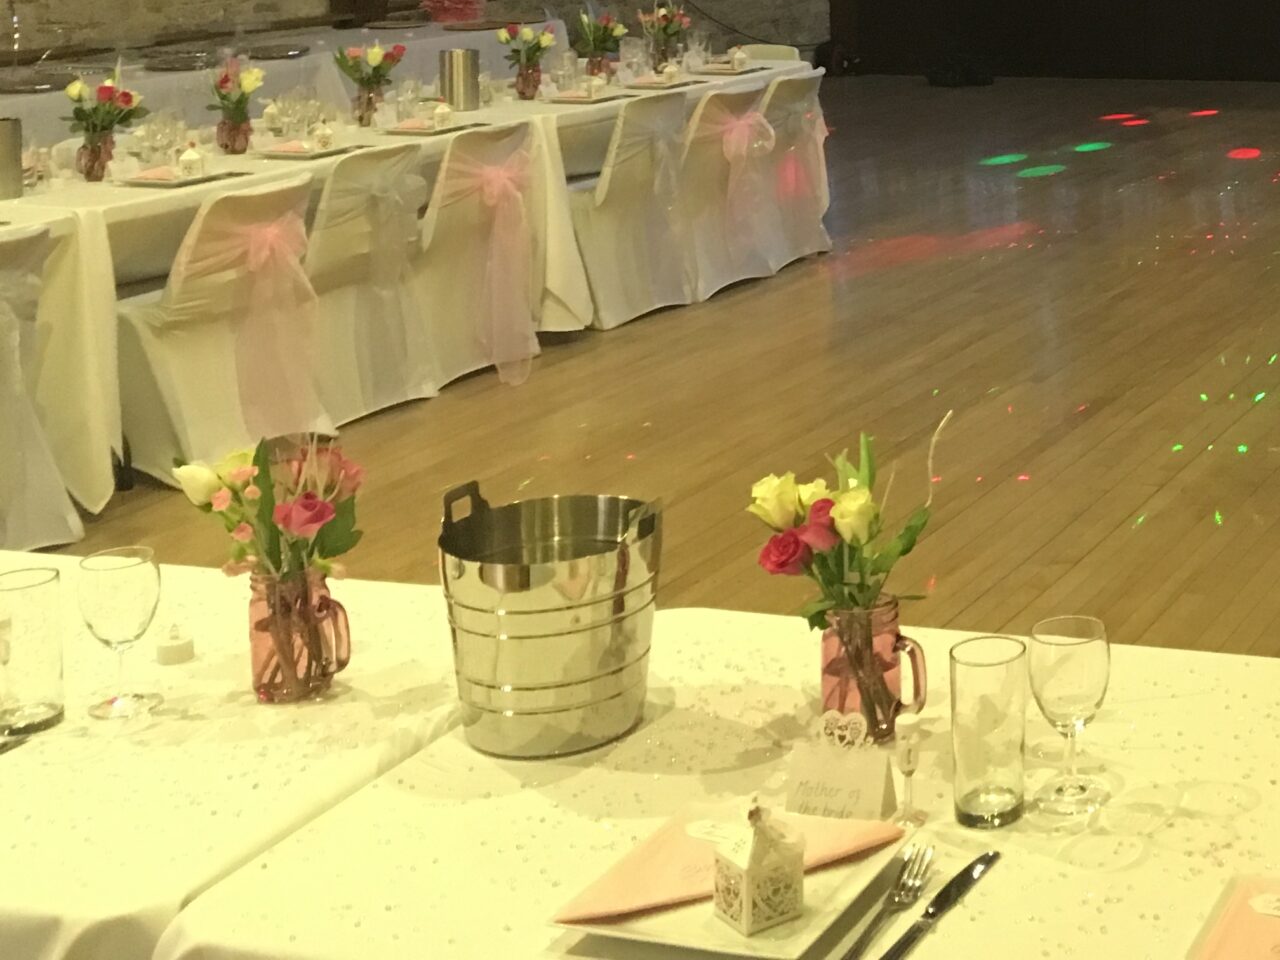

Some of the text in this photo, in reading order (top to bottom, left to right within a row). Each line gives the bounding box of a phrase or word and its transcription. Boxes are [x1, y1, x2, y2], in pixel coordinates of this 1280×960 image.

[794, 779, 862, 806] Mother of
[798, 800, 819, 815] the
